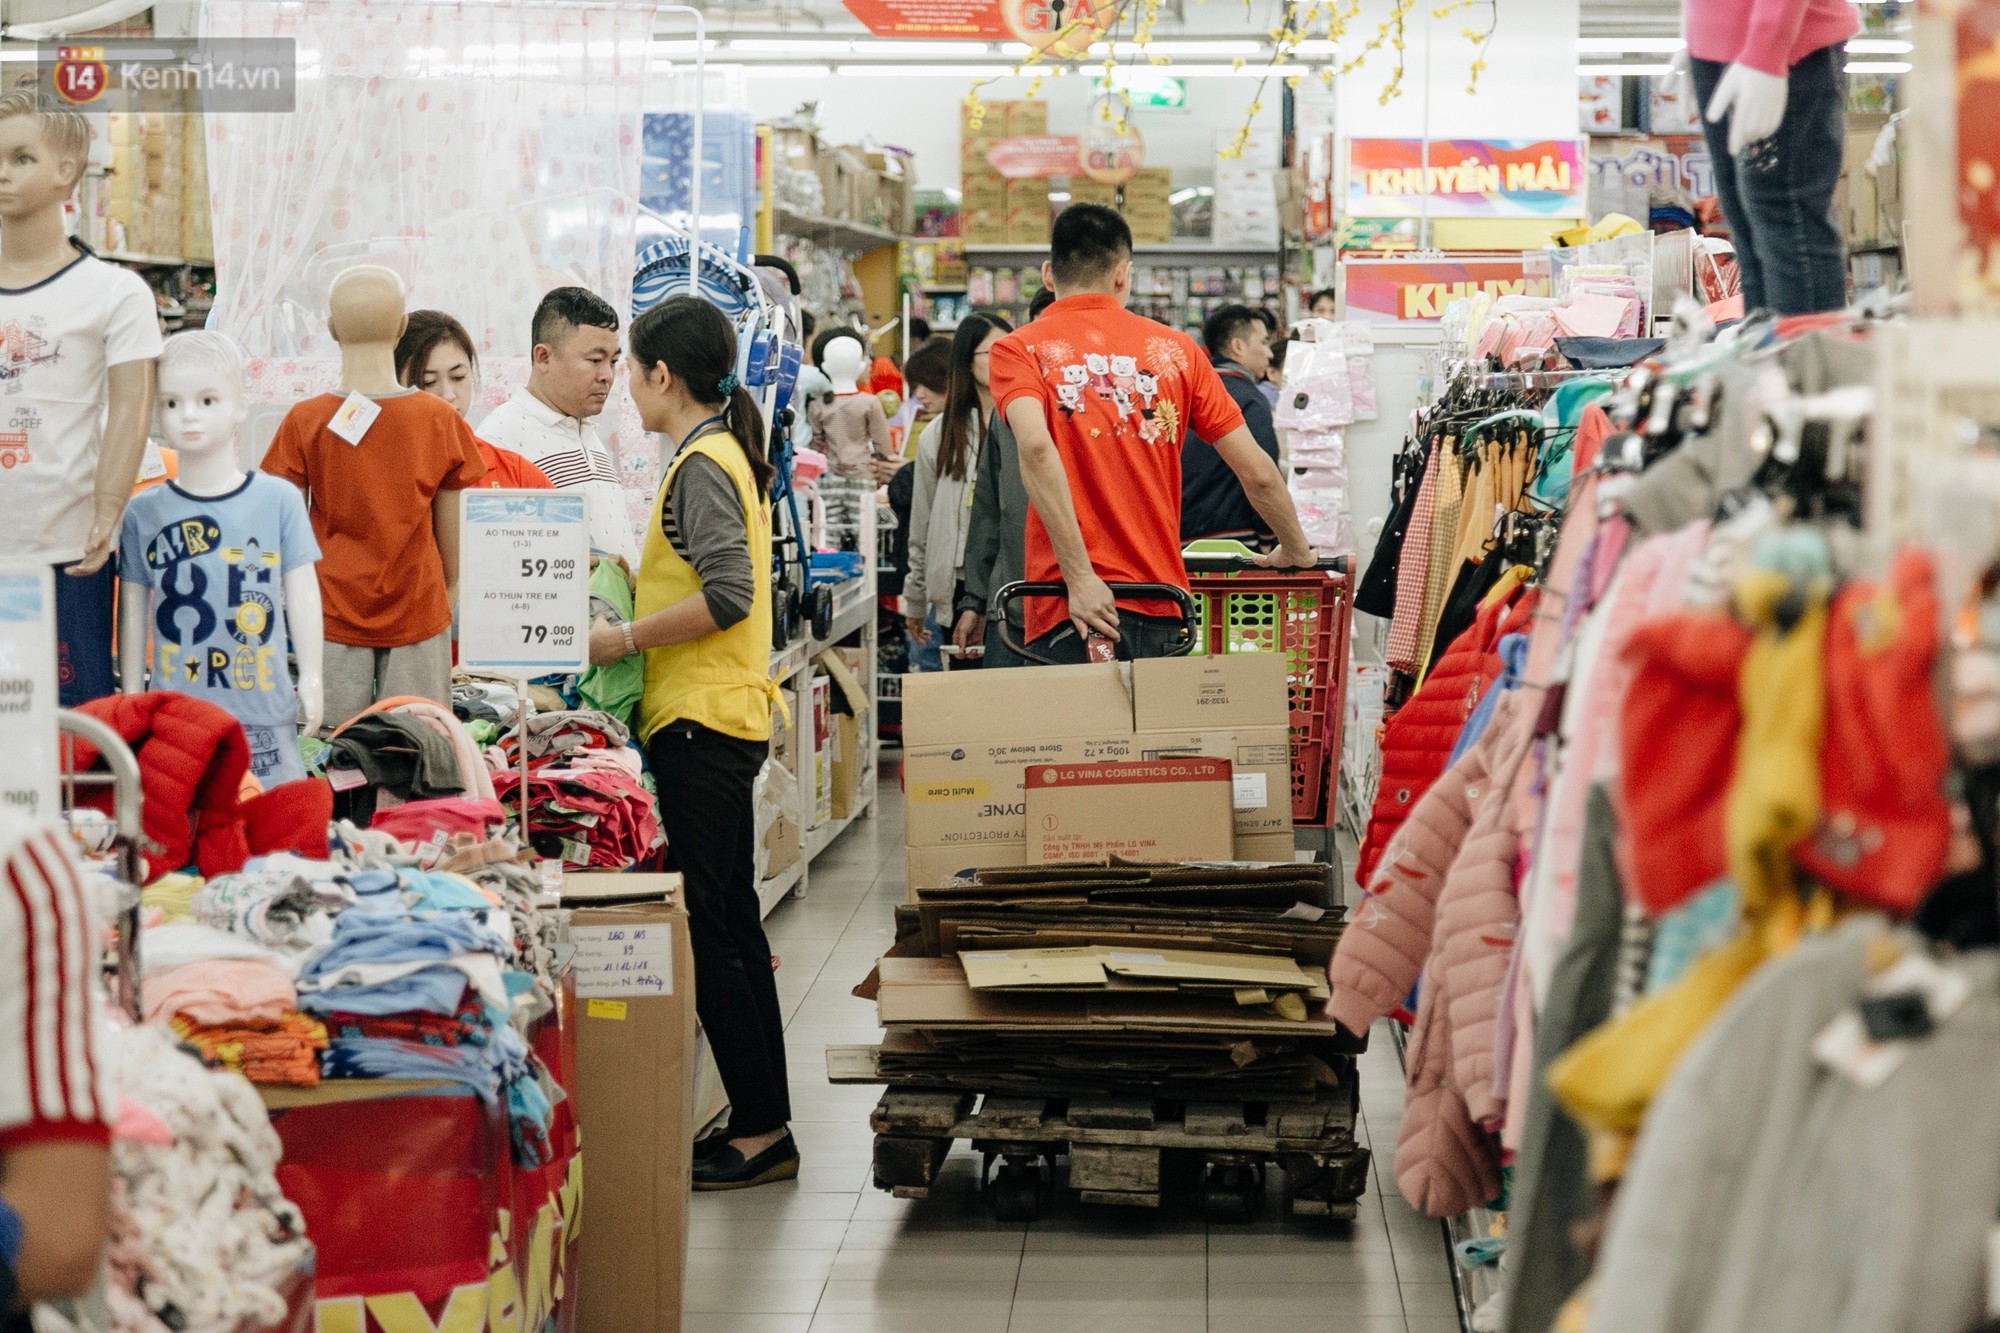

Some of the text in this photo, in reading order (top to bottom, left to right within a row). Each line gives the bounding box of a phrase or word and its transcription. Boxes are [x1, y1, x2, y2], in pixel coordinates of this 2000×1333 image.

[1366, 156, 1500, 194] KHUYẾN
[9, 418, 43, 429] CHIEF
[501, 529, 525, 537] THUN
[546, 529, 560, 537] EM
[513, 540, 532, 549] (1-3)
[521, 558, 548, 578] 59
[553, 571, 573, 580] vnd
[500, 592, 523, 600] THUN
[544, 592, 558, 600] EM
[511, 602, 530, 612] (4-8)
[521, 625, 548, 644] 79
[552, 636, 573, 646] vnd
[1010, 745, 1036, 754] below
[1038, 744, 1063, 753] Store
[1084, 748, 1096, 757] 72
[1107, 746, 1130, 756] 100g
[1060, 765, 1216, 780] LG VINA COSMETICS CO., LTD
[928, 787, 975, 796] Multi Care
[1263, 819, 1282, 827] 24/7
[1071, 842, 1091, 850] TNHH
[1139, 840, 1157, 848] VINA
